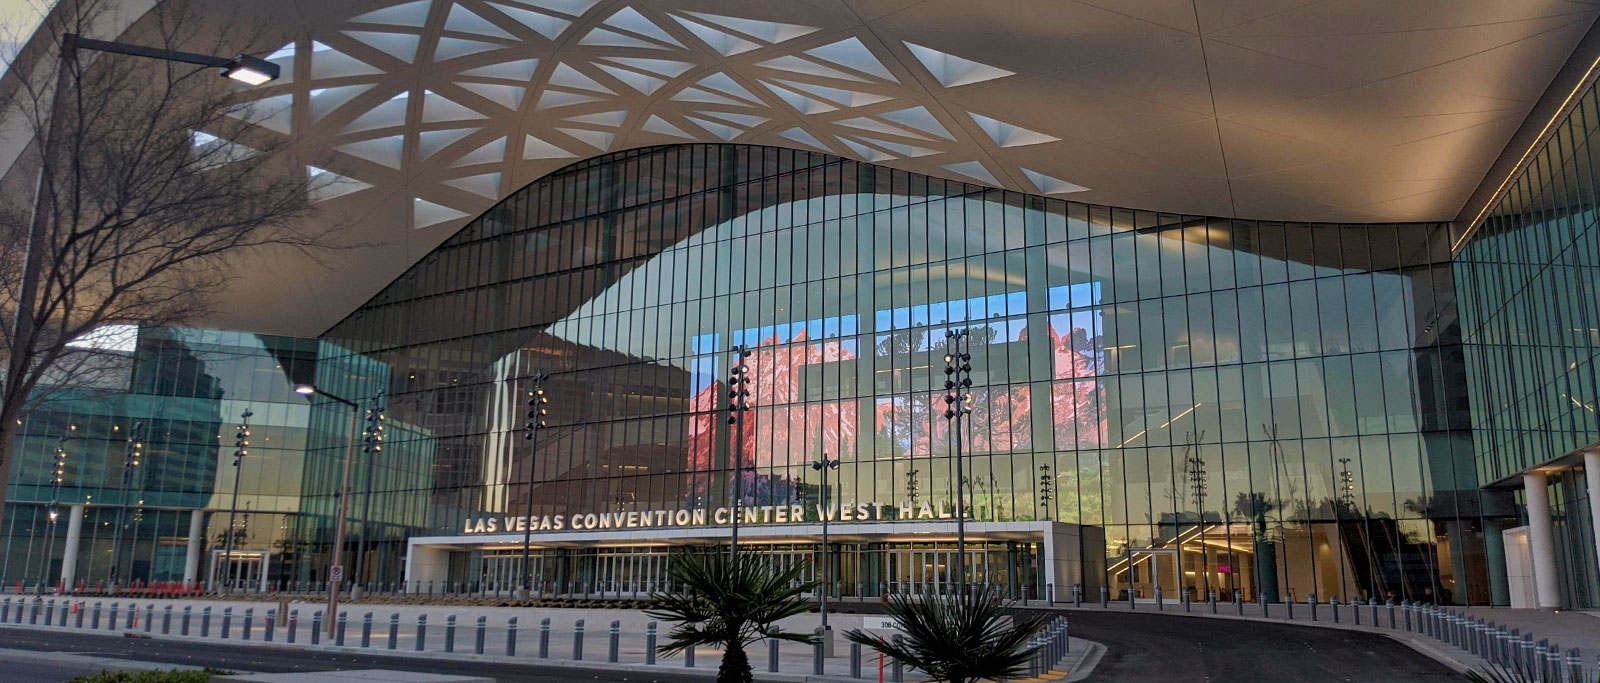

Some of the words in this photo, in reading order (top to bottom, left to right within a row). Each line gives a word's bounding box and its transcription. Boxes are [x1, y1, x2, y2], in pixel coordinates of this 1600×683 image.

[464, 518, 497, 533] LAS
[505, 515, 565, 532] VEGAS
[571, 508, 707, 530] CONVENTION
[714, 504, 805, 525] CENTER
[816, 501, 885, 521] WEST
[899, 500, 968, 519] HALL
